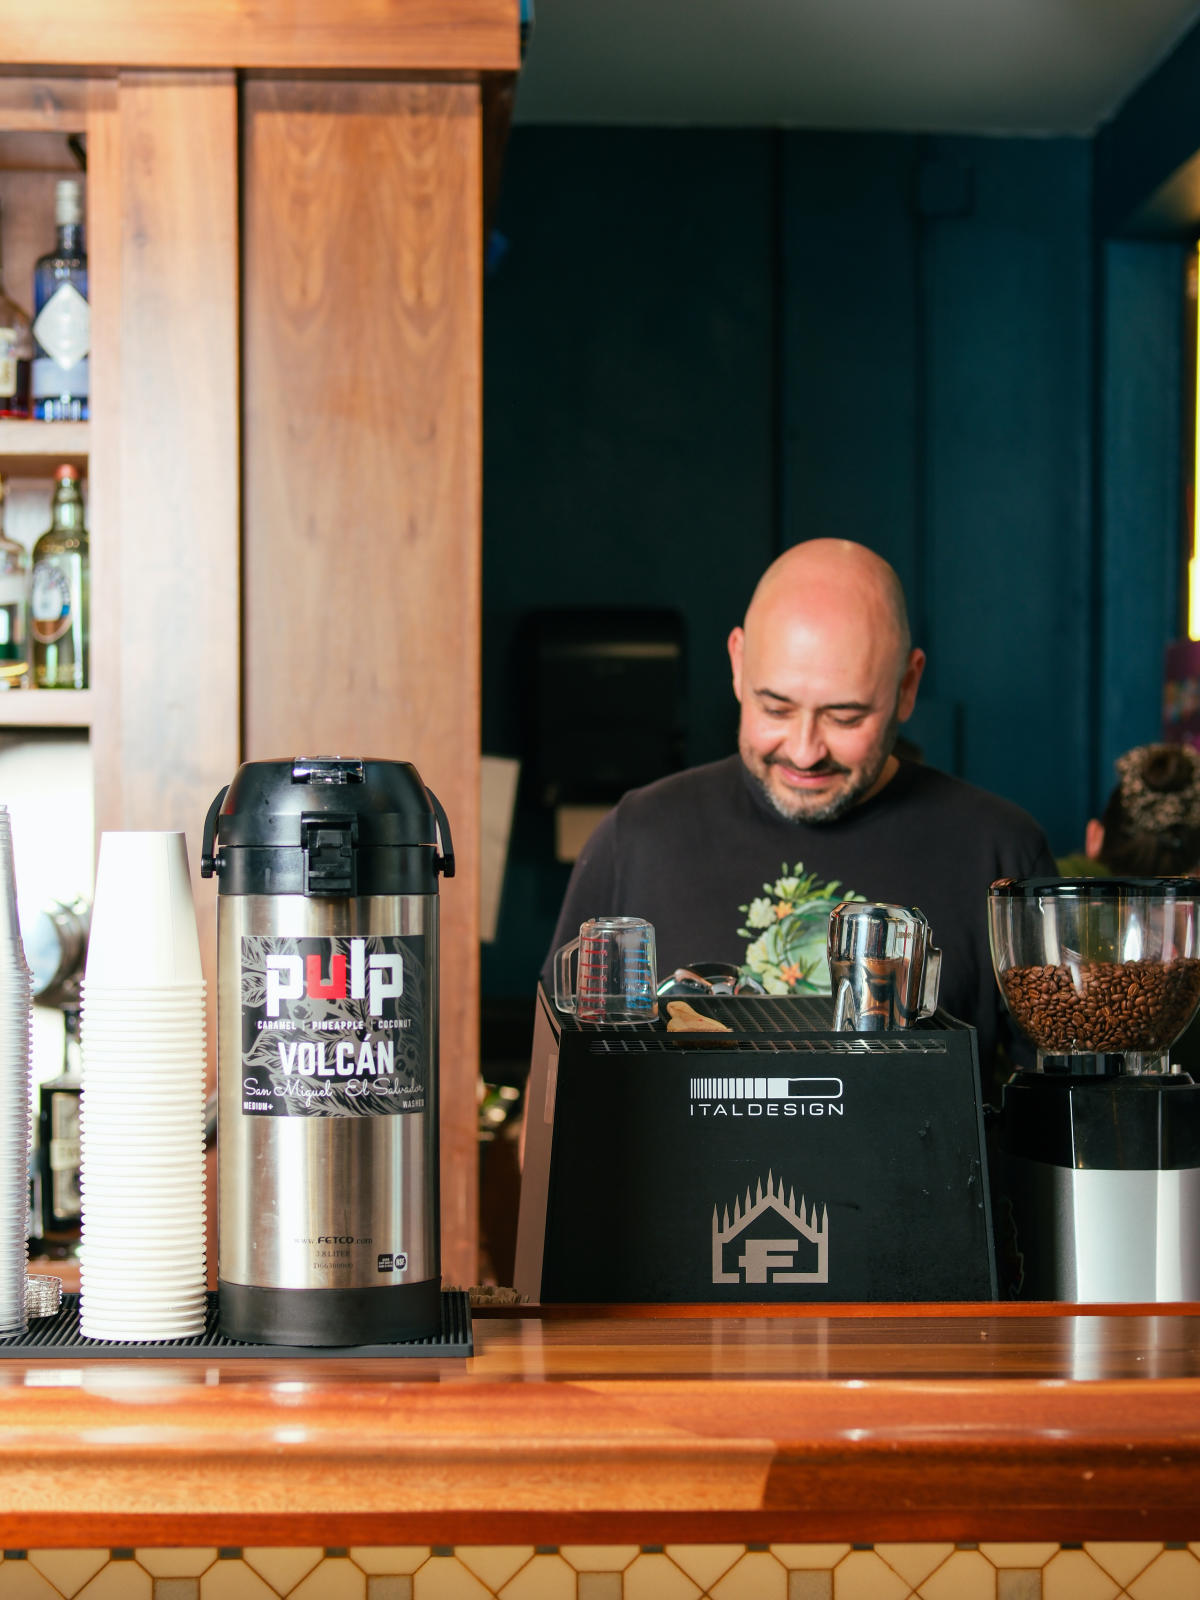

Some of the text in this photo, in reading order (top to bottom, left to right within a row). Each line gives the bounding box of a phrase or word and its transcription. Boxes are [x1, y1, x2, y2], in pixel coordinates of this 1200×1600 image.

[266, 939, 403, 1017] pulp
[257, 1019, 412, 1031] CARAMEL PINEAPPLE COCONUT
[278, 1034, 395, 1076] VOLCÁN
[243, 1077, 424, 1108] San Miguel El Salvador
[690, 1103, 843, 1116] ITALDESIGN
